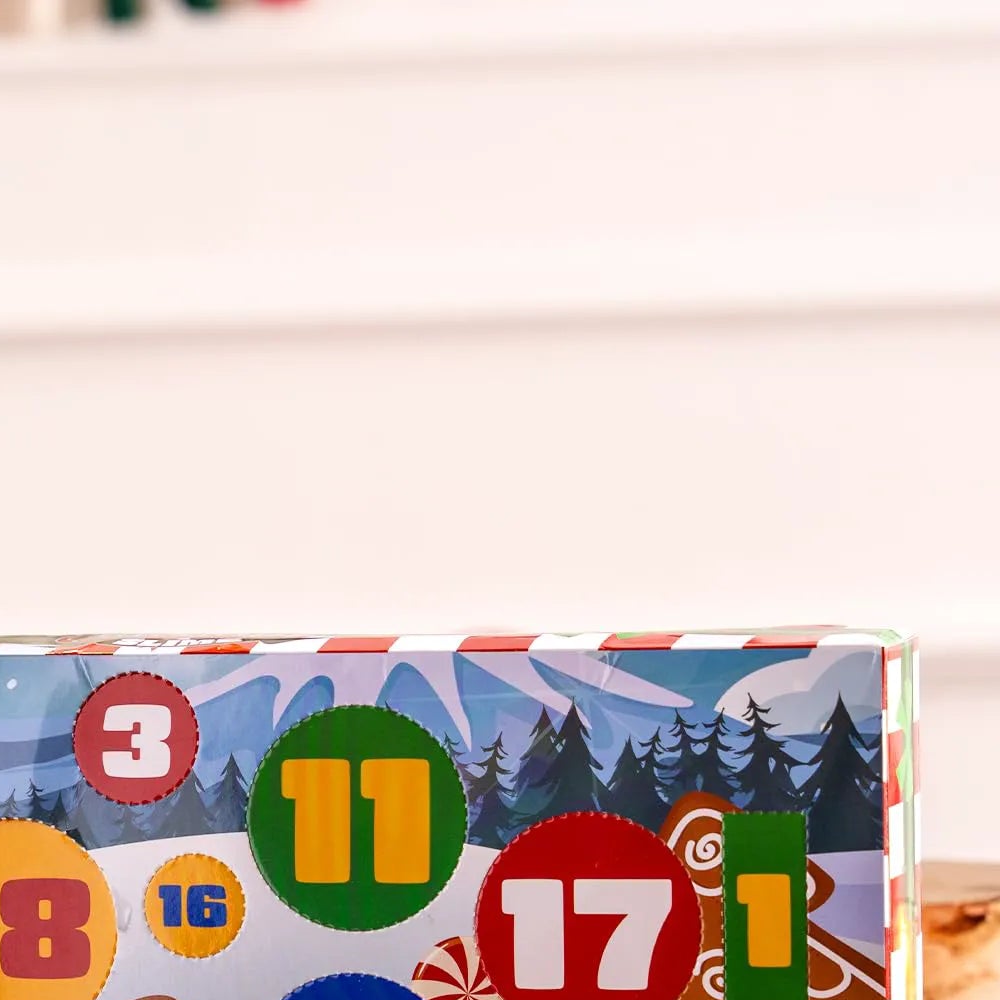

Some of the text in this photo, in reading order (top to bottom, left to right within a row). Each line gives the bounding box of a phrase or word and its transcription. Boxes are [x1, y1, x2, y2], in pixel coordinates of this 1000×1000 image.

[102, 704, 172, 779] 3
[281, 758, 431, 884] 11
[158, 884, 226, 927] 16
[500, 879, 672, 990] 17
[736, 874, 792, 968] 1
